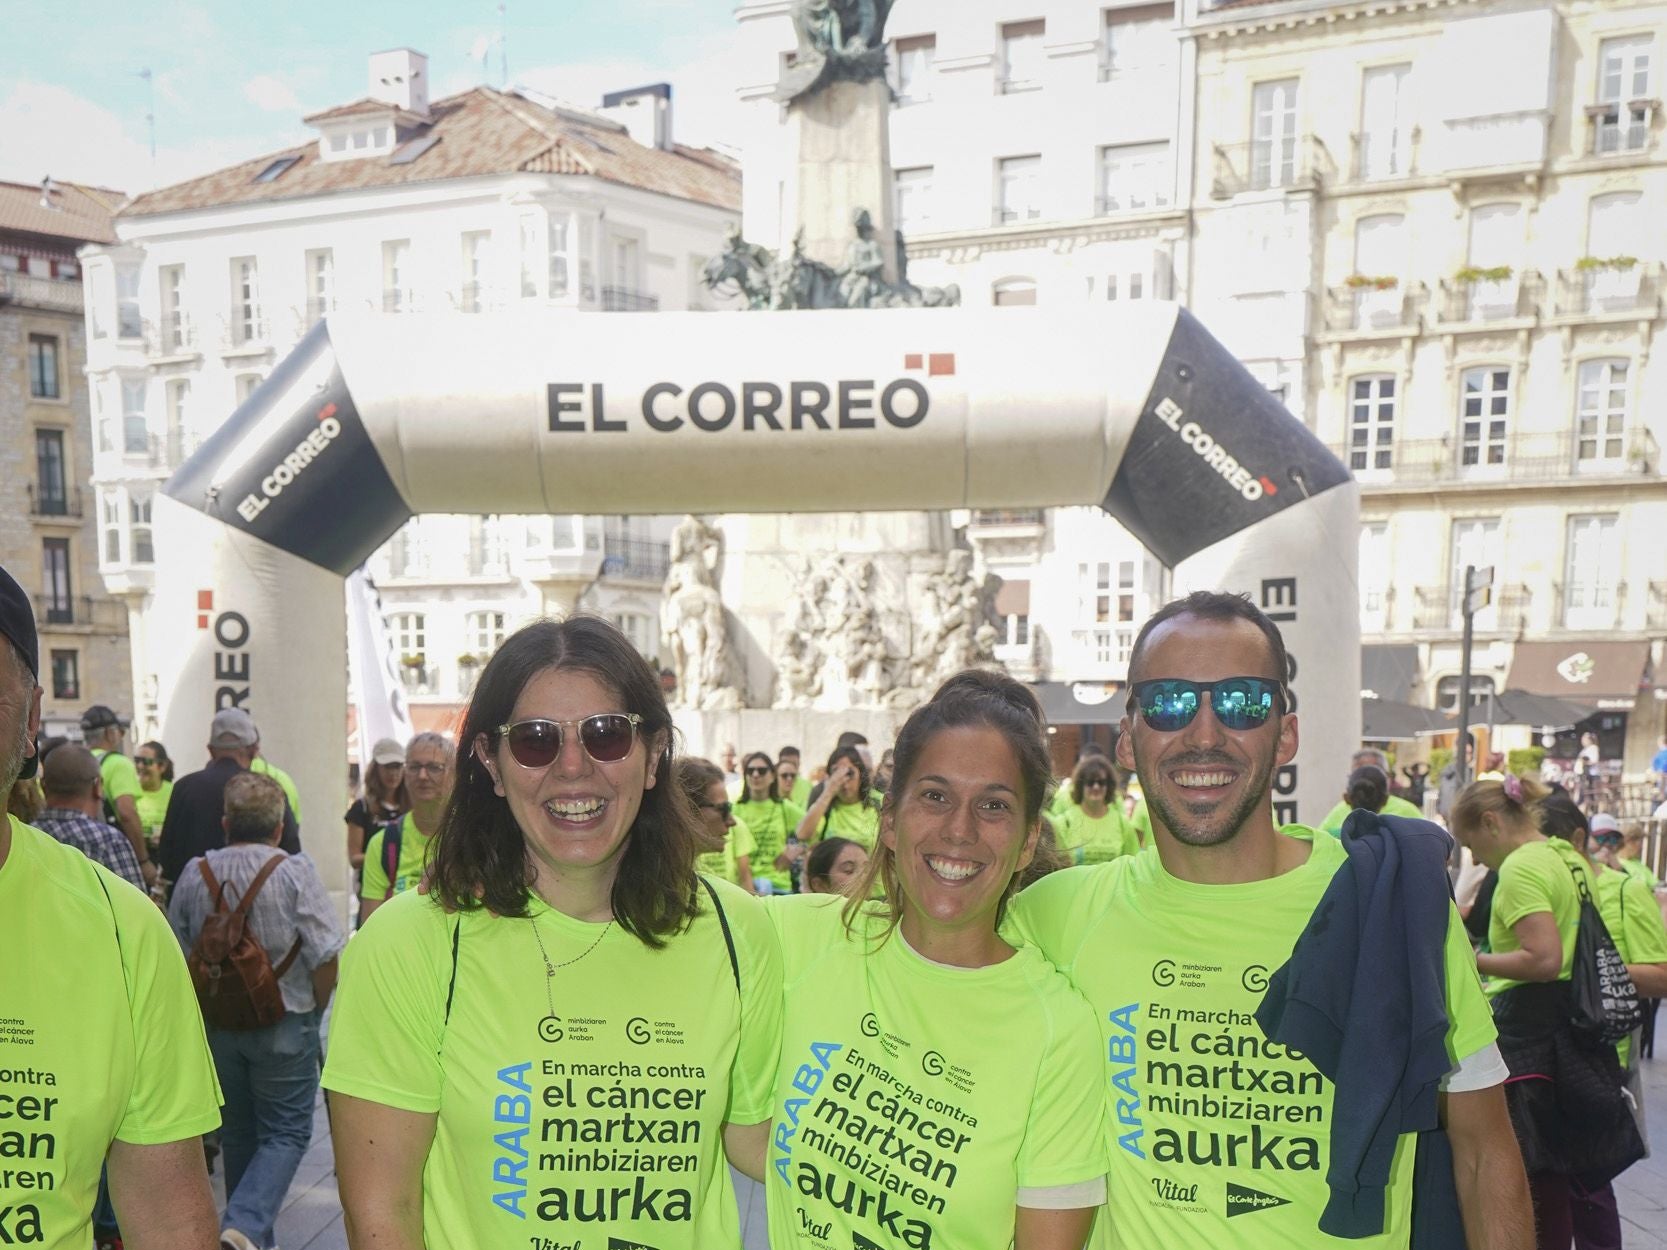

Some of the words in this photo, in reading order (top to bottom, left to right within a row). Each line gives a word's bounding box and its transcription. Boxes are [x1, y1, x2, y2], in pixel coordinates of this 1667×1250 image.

[547, 382, 628, 432] EL
[641, 378, 930, 432] CORREO
[236, 493, 270, 522] EL
[261, 417, 341, 497] CORREO
[1154, 397, 1183, 432] EL
[1180, 422, 1263, 500] CORREO
[214, 611, 251, 714] REO
[1180, 972, 1201, 980] aurka
[1148, 1003, 1171, 1020] En
[1176, 1006, 1253, 1026] marcha
[1146, 1023, 1180, 1053] el
[1190, 1028, 1307, 1061] cánc
[542, 1060, 565, 1075] En
[571, 1061, 641, 1077] marcha
[647, 1064, 705, 1079] contra
[845, 1048, 865, 1069] En
[866, 1064, 923, 1105] marcha
[926, 1098, 978, 1128] contra
[1109, 1002, 1147, 1161] ARABA
[1146, 1060, 1323, 1095] martxan
[542, 1079, 577, 1108] el
[586, 1080, 706, 1110] cáncer
[774, 1041, 844, 1189] ARABA
[832, 1072, 865, 1101] el
[866, 1090, 971, 1154] cáncer
[1148, 1093, 1323, 1123] minbiziaren
[491, 1061, 532, 1220] ARABA
[541, 1113, 701, 1144] martxan
[813, 1096, 958, 1188] martxan
[1152, 1124, 1320, 1171] aurka
[0, 1169, 54, 1190] ren
[538, 1149, 698, 1172] minbiziaren
[801, 1126, 946, 1215] minbiziaren
[536, 1176, 692, 1222] aurka
[1151, 1178, 1198, 1203] Vital
